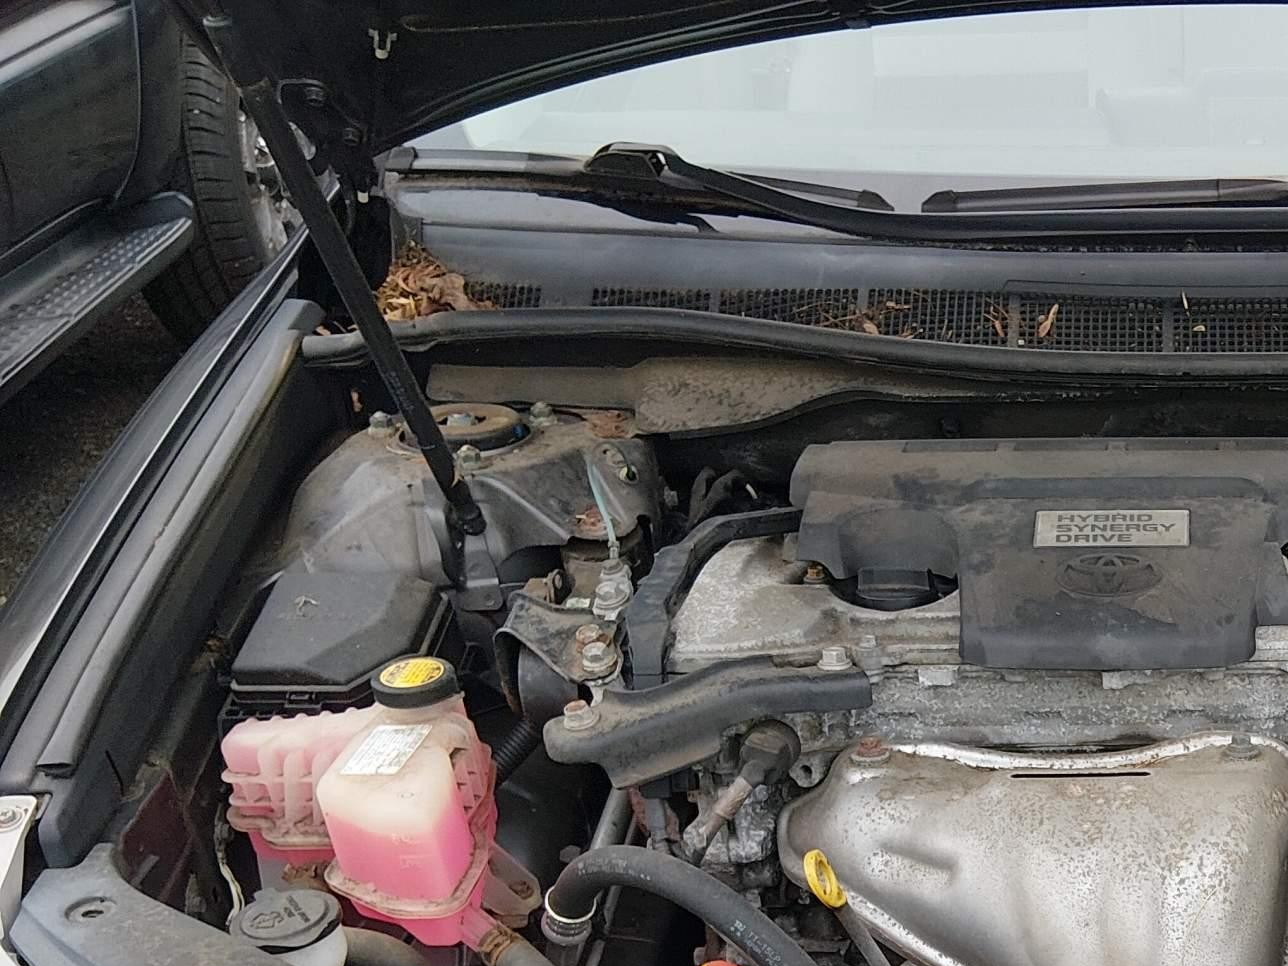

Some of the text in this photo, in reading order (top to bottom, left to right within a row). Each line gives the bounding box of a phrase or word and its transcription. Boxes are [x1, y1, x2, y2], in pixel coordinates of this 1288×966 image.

[1057, 514, 1153, 523] HYBRID
[1056, 523, 1176, 532] SYNERGY
[1055, 533, 1133, 543] DRIVE
